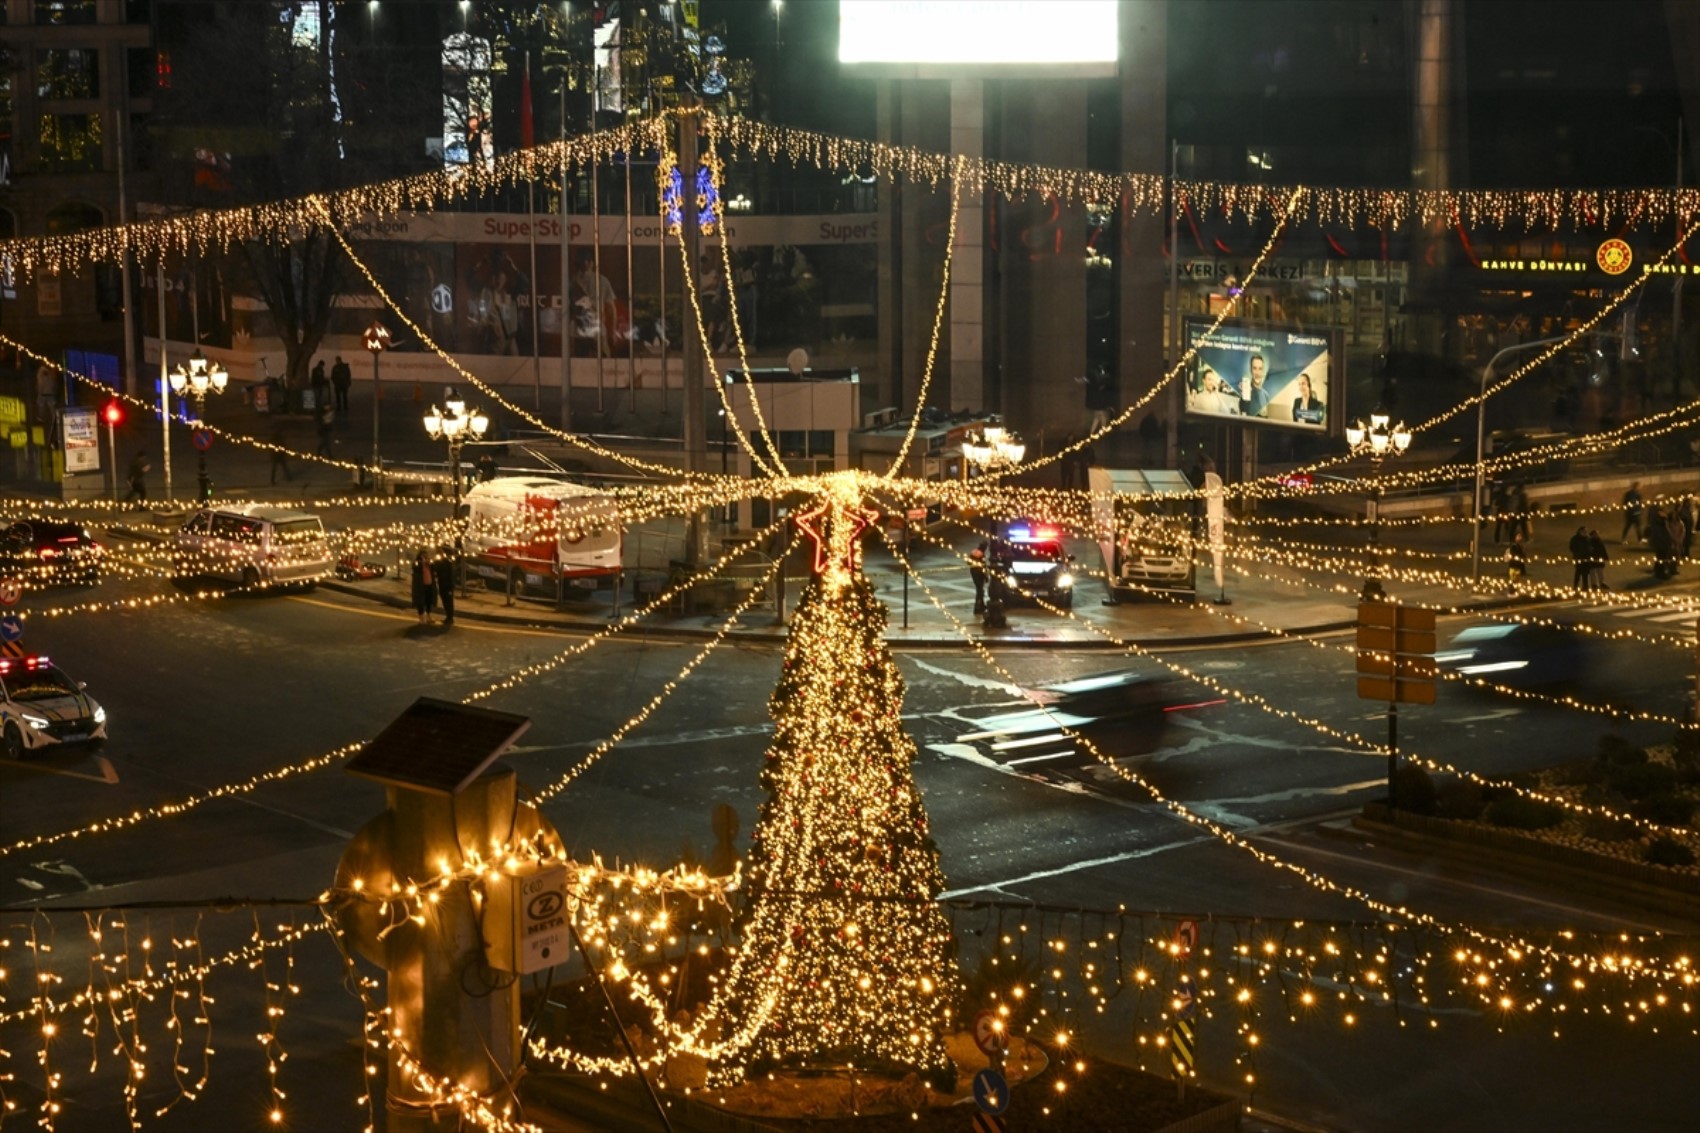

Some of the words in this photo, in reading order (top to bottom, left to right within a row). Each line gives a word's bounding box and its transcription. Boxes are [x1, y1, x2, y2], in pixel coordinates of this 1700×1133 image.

[1482, 260, 1524, 270] KAHVE
[1530, 259, 1586, 271] DÜNYASI
[367, 339, 382, 349] M
[528, 916, 564, 934] META
